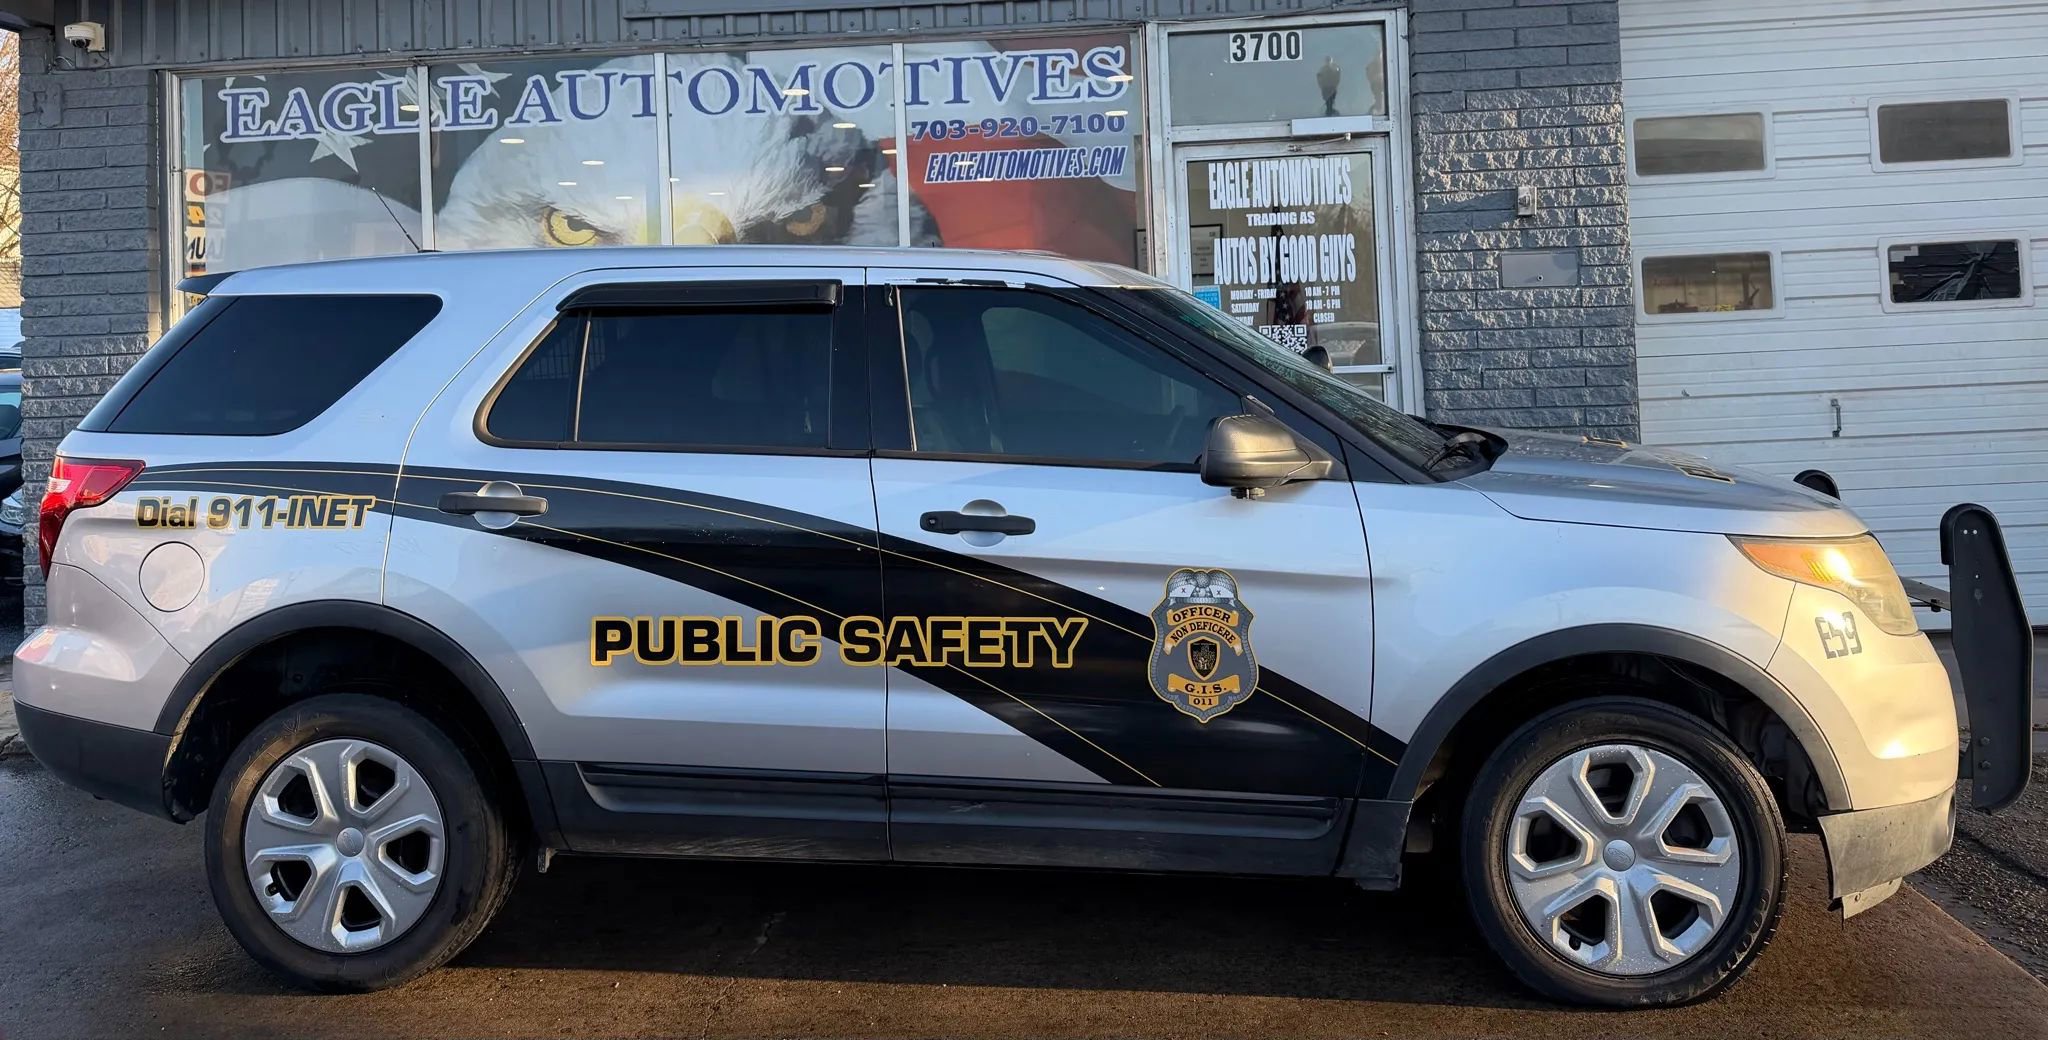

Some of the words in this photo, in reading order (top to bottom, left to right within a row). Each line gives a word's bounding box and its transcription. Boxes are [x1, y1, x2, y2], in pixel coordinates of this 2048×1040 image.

[1231, 31, 1301, 62] 3700
[218, 76, 497, 142] EAGLE
[506, 47, 1127, 126] AUTOMOTIVES
[911, 113, 1126, 141] 703-920-7100
[925, 146, 1127, 183] EAGLEAUTOMOTIVES.COM
[1208, 161, 1250, 210] EAGLE
[1252, 157, 1352, 208] AUTOMOTIVES
[1246, 212, 1298, 227] TRADING
[1299, 211, 1316, 225] AS
[1213, 236, 1258, 286] AUTOS
[1259, 236, 1277, 284] BY
[1279, 234, 1318, 284] GOOD
[1319, 233, 1357, 283] GUYS
[1230, 289, 1254, 300] MONDAY
[1257, 288, 1277, 299] FRIDAY
[1305, 287, 1312, 297] 10
[1313, 286, 1322, 296] AM
[1325, 286, 1329, 296] 7
[1331, 285, 1340, 296] PM
[1231, 302, 1260, 313] SATURDAY
[1313, 299, 1322, 310] AM
[1331, 299, 1341, 309] PM
[1313, 312, 1335, 323] CLOSED
[136, 496, 198, 529] Dial
[207, 495, 376, 530] 911-INET
[1172, 606, 1231, 623] OFFICER
[591, 616, 822, 667] PUBLIC
[839, 616, 1089, 667] SAFETY
[1170, 622, 1189, 643] NON
[1190, 621, 1236, 644] DEFICERE
[1184, 683, 1227, 694] G.I.S.
[1193, 697, 1213, 706] 011
